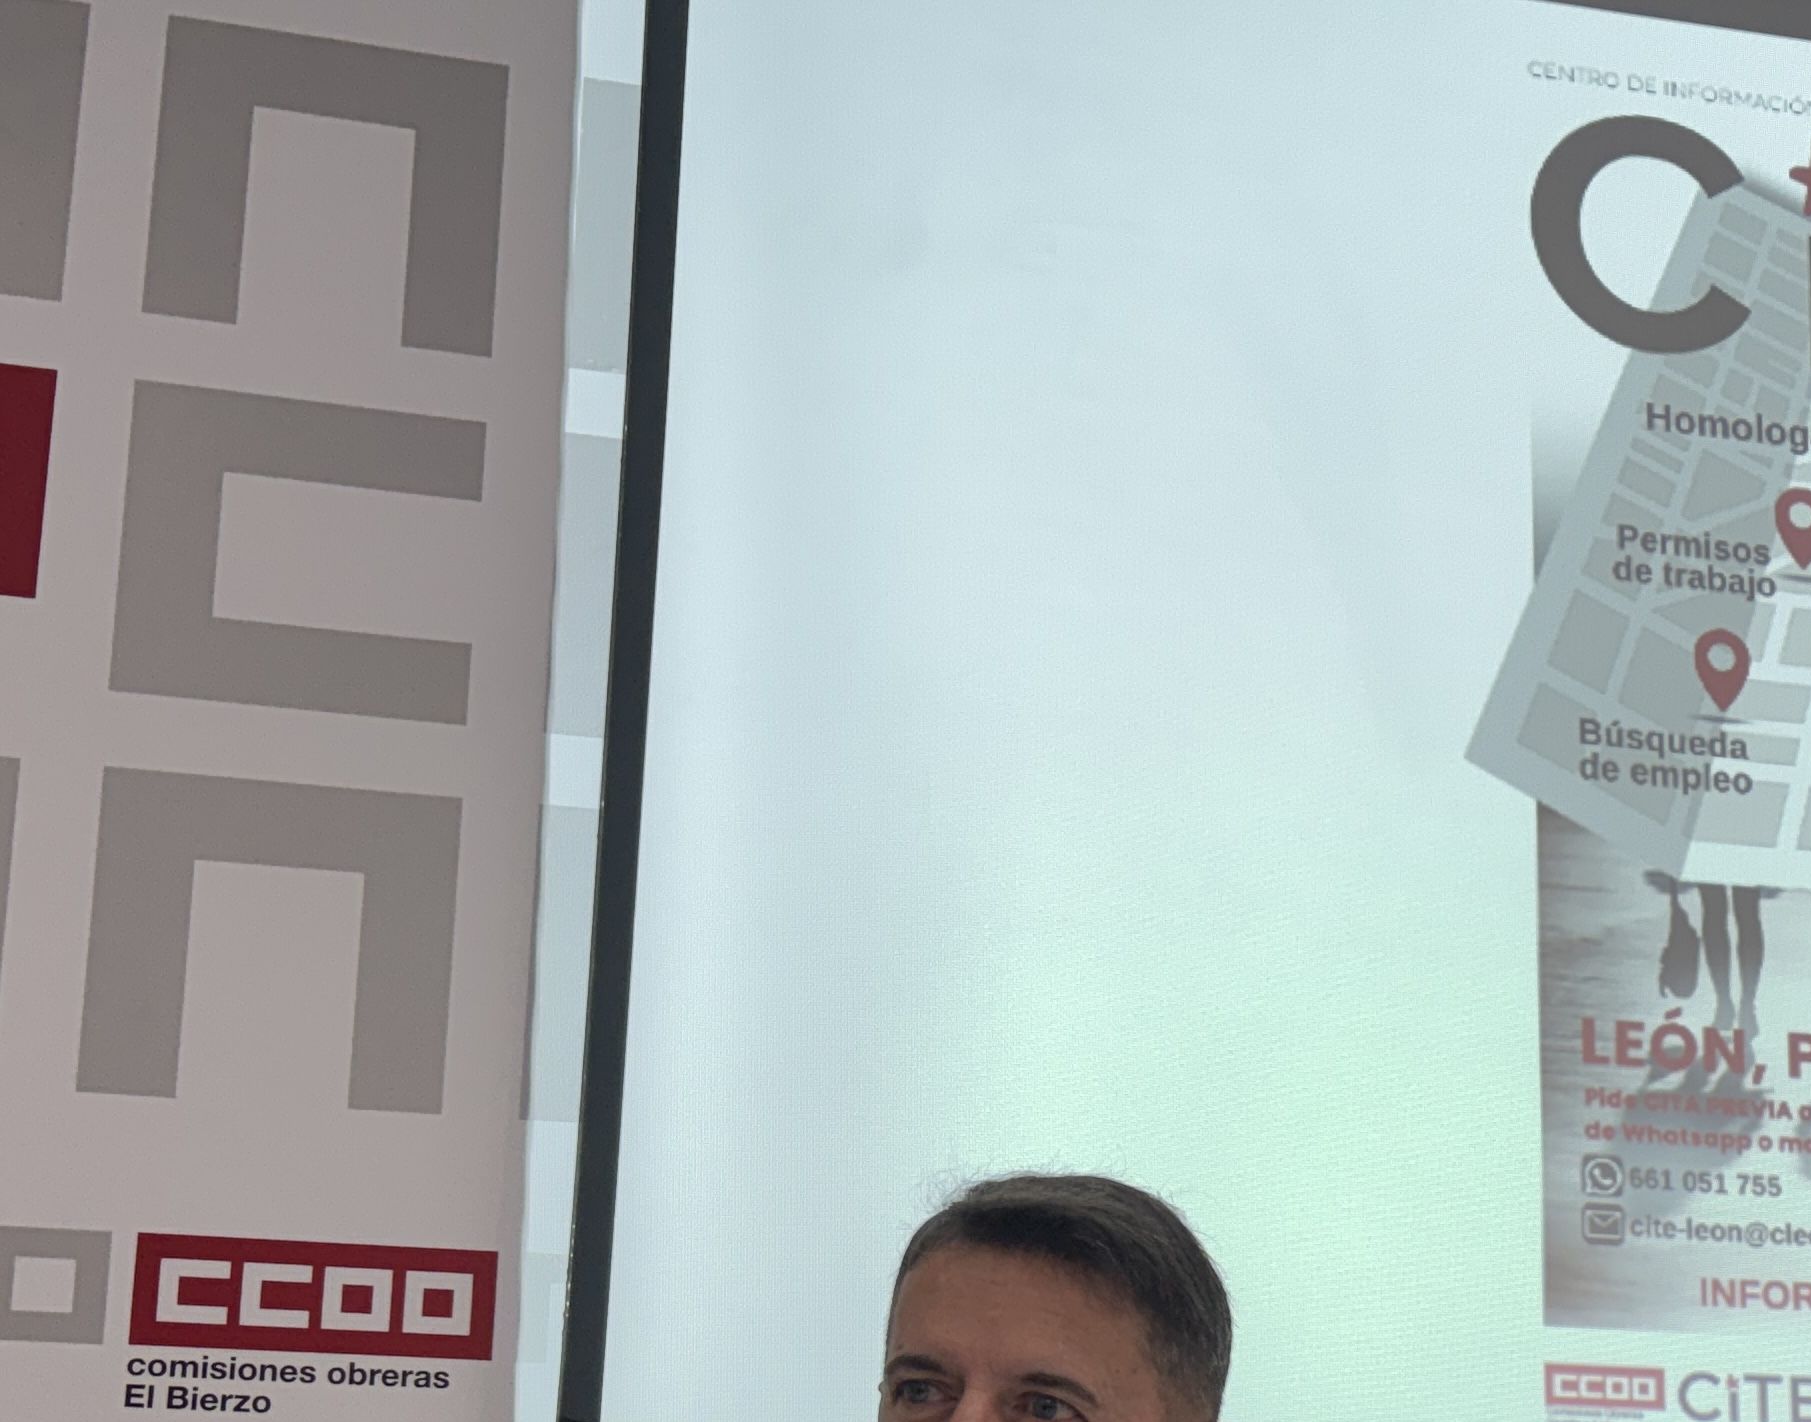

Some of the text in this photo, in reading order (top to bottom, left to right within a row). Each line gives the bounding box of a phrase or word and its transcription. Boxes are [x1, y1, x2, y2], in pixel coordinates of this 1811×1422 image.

[1527, 60, 1620, 89] CENTRO
[1627, 74, 1657, 95] DE
[1616, 525, 1772, 566] Permisos
[1613, 556, 1777, 600] de trabajo
[1579, 716, 1748, 765] Búsqueda
[1579, 752, 1753, 799] de empleo
[1581, 1007, 1768, 1085] LEÓN,
[1585, 1087, 1637, 1111] Pide
[1643, 1092, 1699, 1115] CITA
[1706, 1097, 1793, 1121] PREVIA
[1584, 1123, 1614, 1142] de
[1621, 1122, 1752, 1155] Whatsapp
[1758, 1136, 1773, 1152] o
[1629, 1167, 1782, 1198] 661 051 755
[156, 1258, 474, 1336] CCOO
[126, 1356, 450, 1389] comisiones obreras
[1551, 1373, 1657, 1402] CCOO
[124, 1384, 271, 1414] El Bierzo
